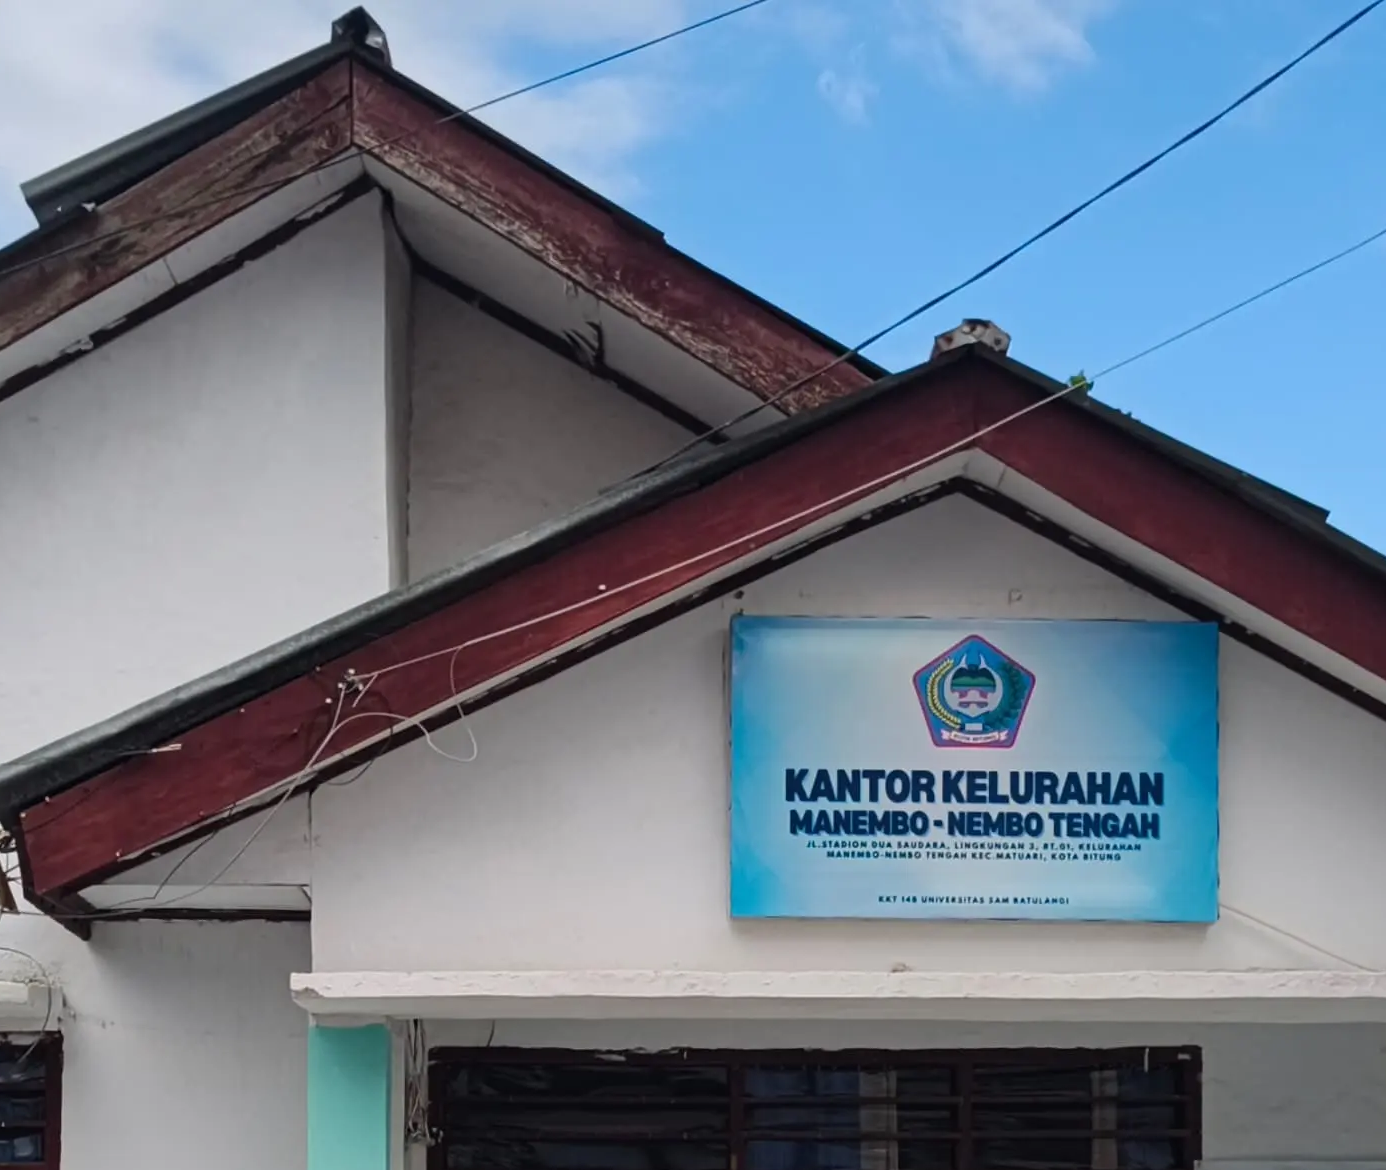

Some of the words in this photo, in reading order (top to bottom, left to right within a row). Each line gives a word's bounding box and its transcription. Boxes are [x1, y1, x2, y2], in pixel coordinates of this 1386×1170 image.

[785, 768, 935, 803] KANTOR
[942, 770, 1164, 806] KELURAHAN
[789, 809, 929, 836] MANEMBO
[933, 819, 943, 828] -
[948, 811, 1044, 838] NEMBO
[1048, 812, 1160, 839] TENGAH
[871, 841, 892, 849] DUA
[897, 841, 950, 850] SAUDARA,
[954, 842, 1025, 850] LINGKUNGAN
[1079, 843, 1142, 851] KELURAHAN
[926, 852, 967, 860] TENGAH
[1051, 853, 1079, 861] KOTA
[1083, 853, 1122, 861] BITUNG
[921, 896, 985, 905] UNIVERSITAS
[988, 897, 1010, 905] SAM
[1013, 897, 1070, 905] RATULANGI
